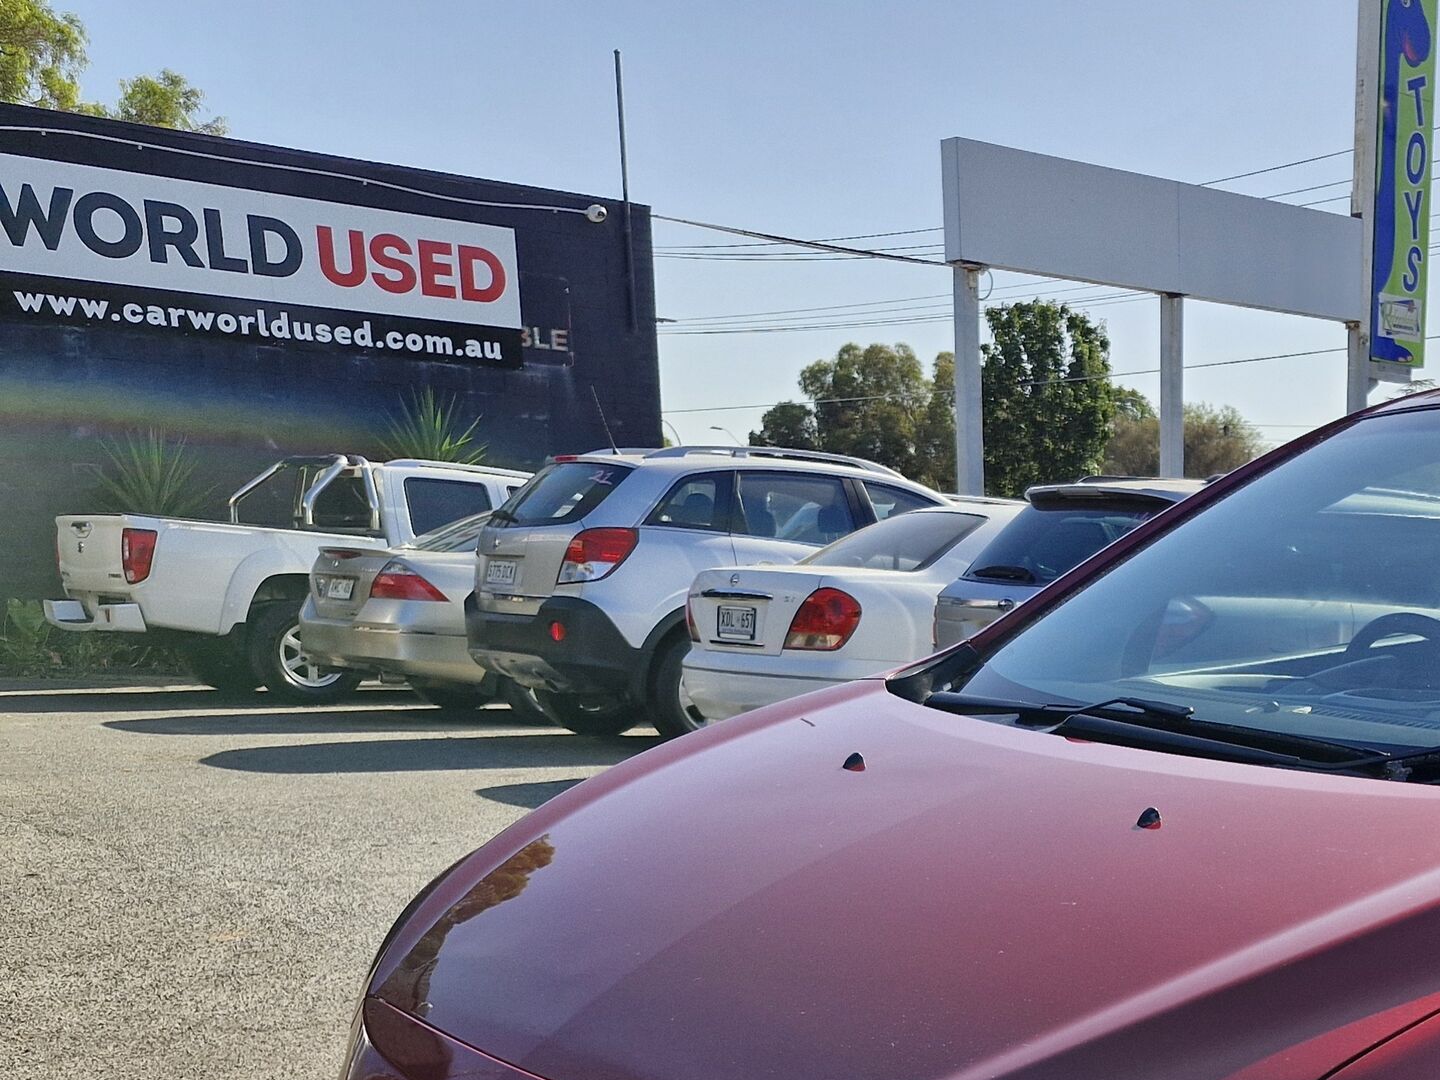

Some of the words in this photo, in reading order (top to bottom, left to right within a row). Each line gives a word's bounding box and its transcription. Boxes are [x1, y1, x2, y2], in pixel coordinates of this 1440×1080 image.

[0, 183, 303, 277] WORLD
[316, 225, 506, 303] USED
[1402, 76, 1427, 293] TOYS
[13, 290, 502, 360] www.carworldused.com.au
